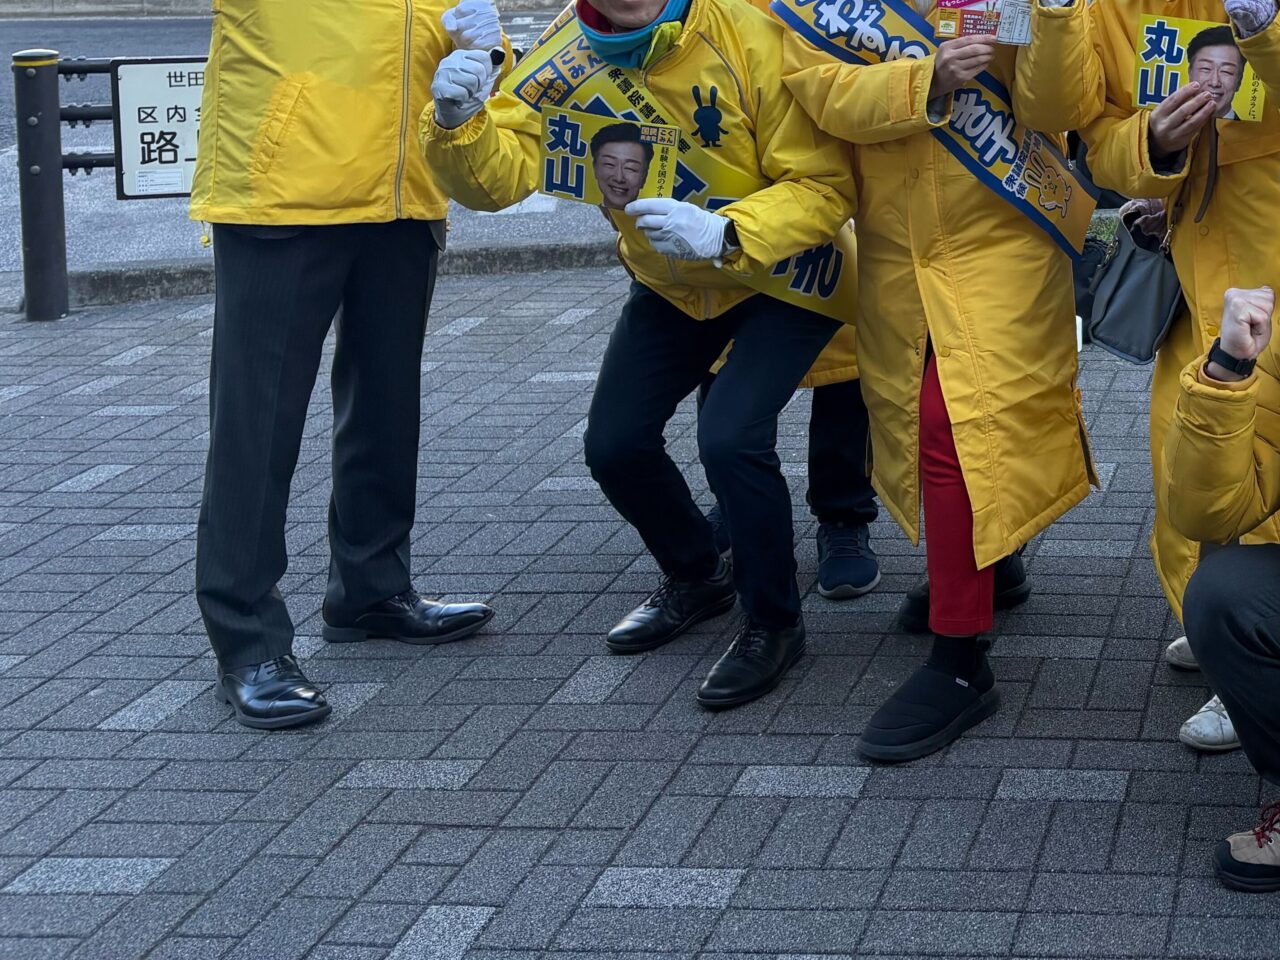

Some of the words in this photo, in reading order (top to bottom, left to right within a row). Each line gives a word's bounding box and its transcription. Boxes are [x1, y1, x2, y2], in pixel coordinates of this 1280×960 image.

[1139, 20, 1184, 106] 丸山
[138, 105, 201, 124] 区内
[659, 128, 674, 137] こく
[659, 136, 674, 144] みん
[140, 130, 200, 166] 路
[544, 113, 588, 199] 丸山
